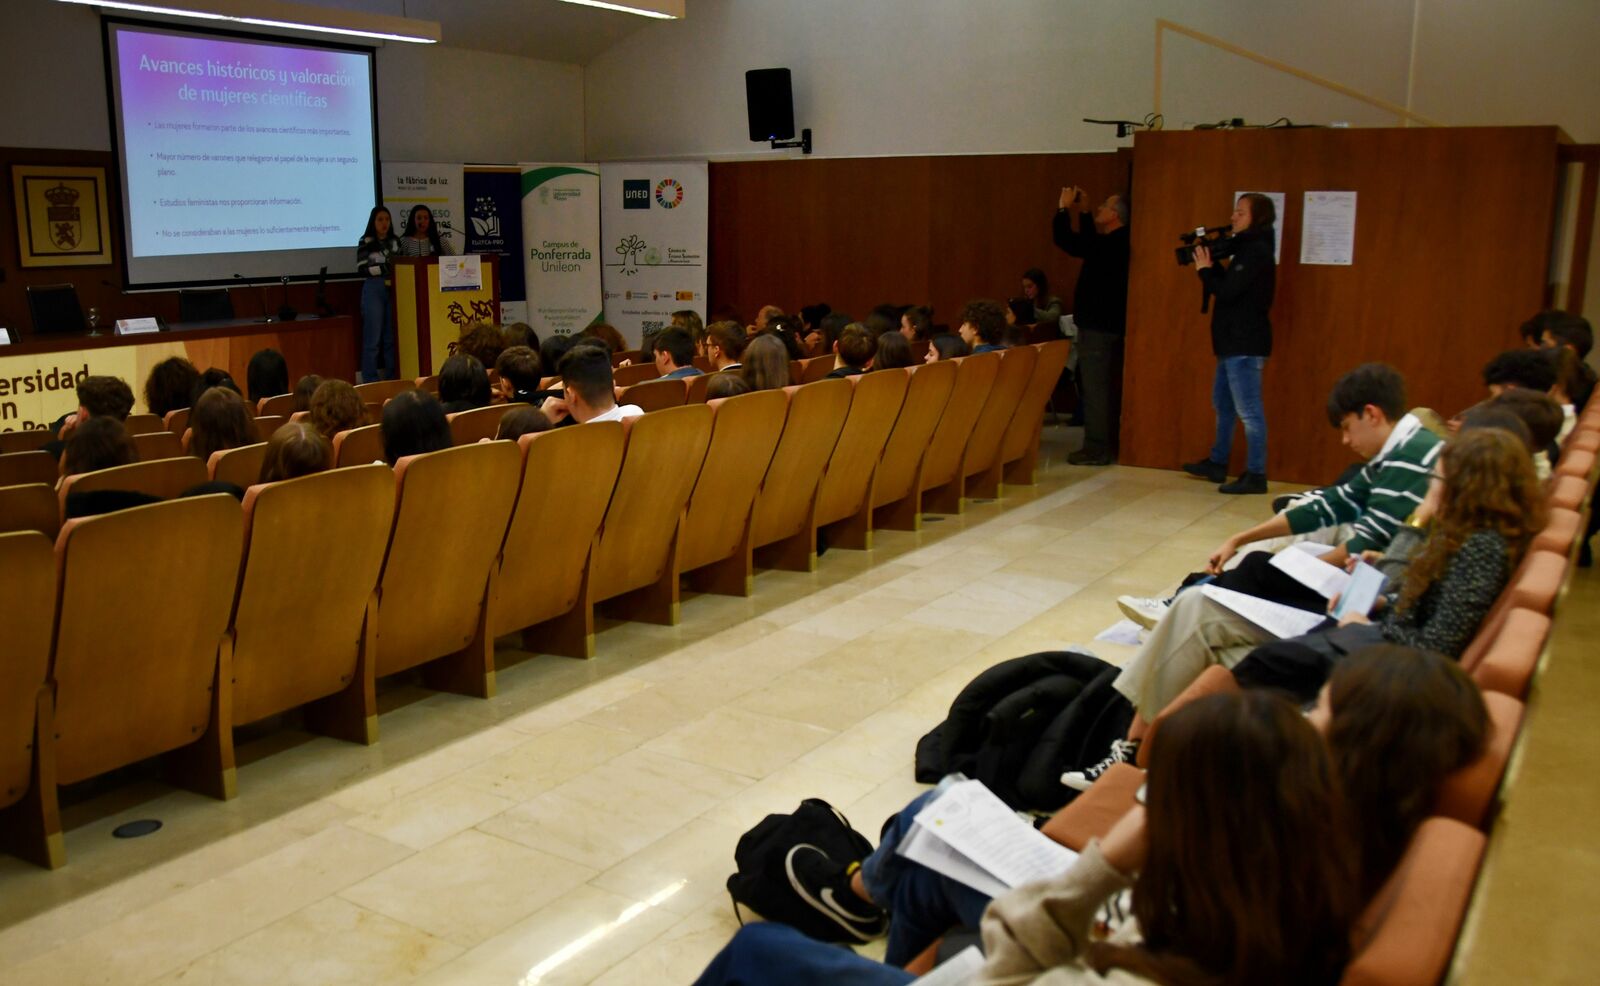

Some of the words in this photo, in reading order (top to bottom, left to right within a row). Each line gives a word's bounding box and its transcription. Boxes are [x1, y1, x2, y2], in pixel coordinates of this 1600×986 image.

[139, 53, 204, 77] Avances
[207, 59, 276, 81] históricos
[279, 70, 289, 86] y
[291, 68, 356, 87] valoración
[178, 83, 197, 101] de
[201, 86, 258, 107] mujeres
[261, 89, 328, 109] científicas
[154, 121, 166, 129] Las
[167, 122, 192, 133] mujeres
[221, 124, 237, 134] parte
[246, 124, 255, 132] los
[156, 152, 176, 164] Mayor
[177, 153, 201, 161] número
[202, 153, 210, 161] de
[235, 156, 246, 165] que
[280, 155, 295, 166] papel
[337, 156, 359, 166] segundo
[397, 175, 404, 185] la
[405, 175, 428, 185] fábrica
[429, 176, 438, 185] de
[439, 177, 448, 185] luz
[625, 189, 648, 199] UNED
[159, 198, 187, 207] Estudios
[187, 198, 218, 207] feministas
[219, 199, 230, 207] nos
[231, 199, 268, 208] proporcionan
[162, 229, 172, 238] No
[182, 227, 221, 238] consideraban
[227, 227, 235, 235] las
[236, 228, 260, 238] mujeres
[266, 226, 309, 235] suficientemente
[543, 241, 569, 250] Campus
[570, 240, 581, 249] de
[530, 248, 591, 260] Ponferrada
[541, 261, 581, 273] Unileon
[0, 400, 18, 420] n
